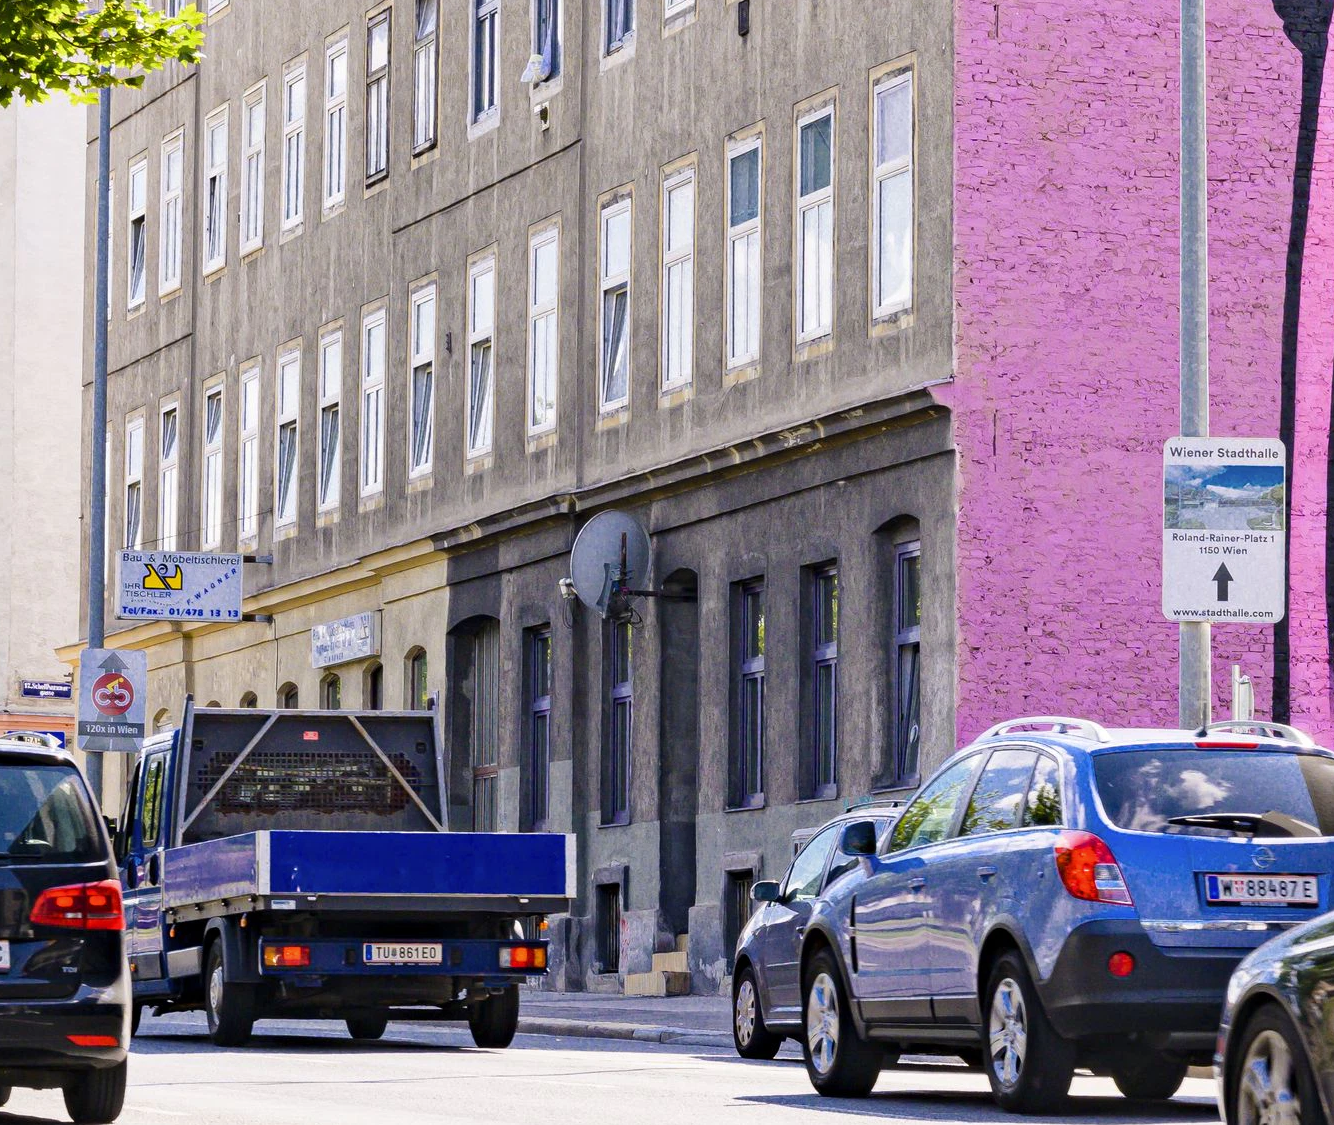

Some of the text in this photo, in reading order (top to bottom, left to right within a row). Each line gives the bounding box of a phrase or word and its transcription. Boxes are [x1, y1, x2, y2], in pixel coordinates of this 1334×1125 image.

[1170, 447, 1279, 459] Wiener Stadthalle
[1172, 533, 1275, 543] Roland-Rainer-Platz 1
[1199, 546, 1248, 555] 1150 Wien
[123, 553, 240, 565] Bau & Möbeltischlerei
[125, 590, 172, 598] TISCHLER
[169, 608, 204, 617] 01/478
[210, 609, 221, 617] 13
[228, 610, 239, 618] 13
[1173, 608, 1274, 618] www.stadthalle.com
[86, 724, 138, 734] 120x in Wien
